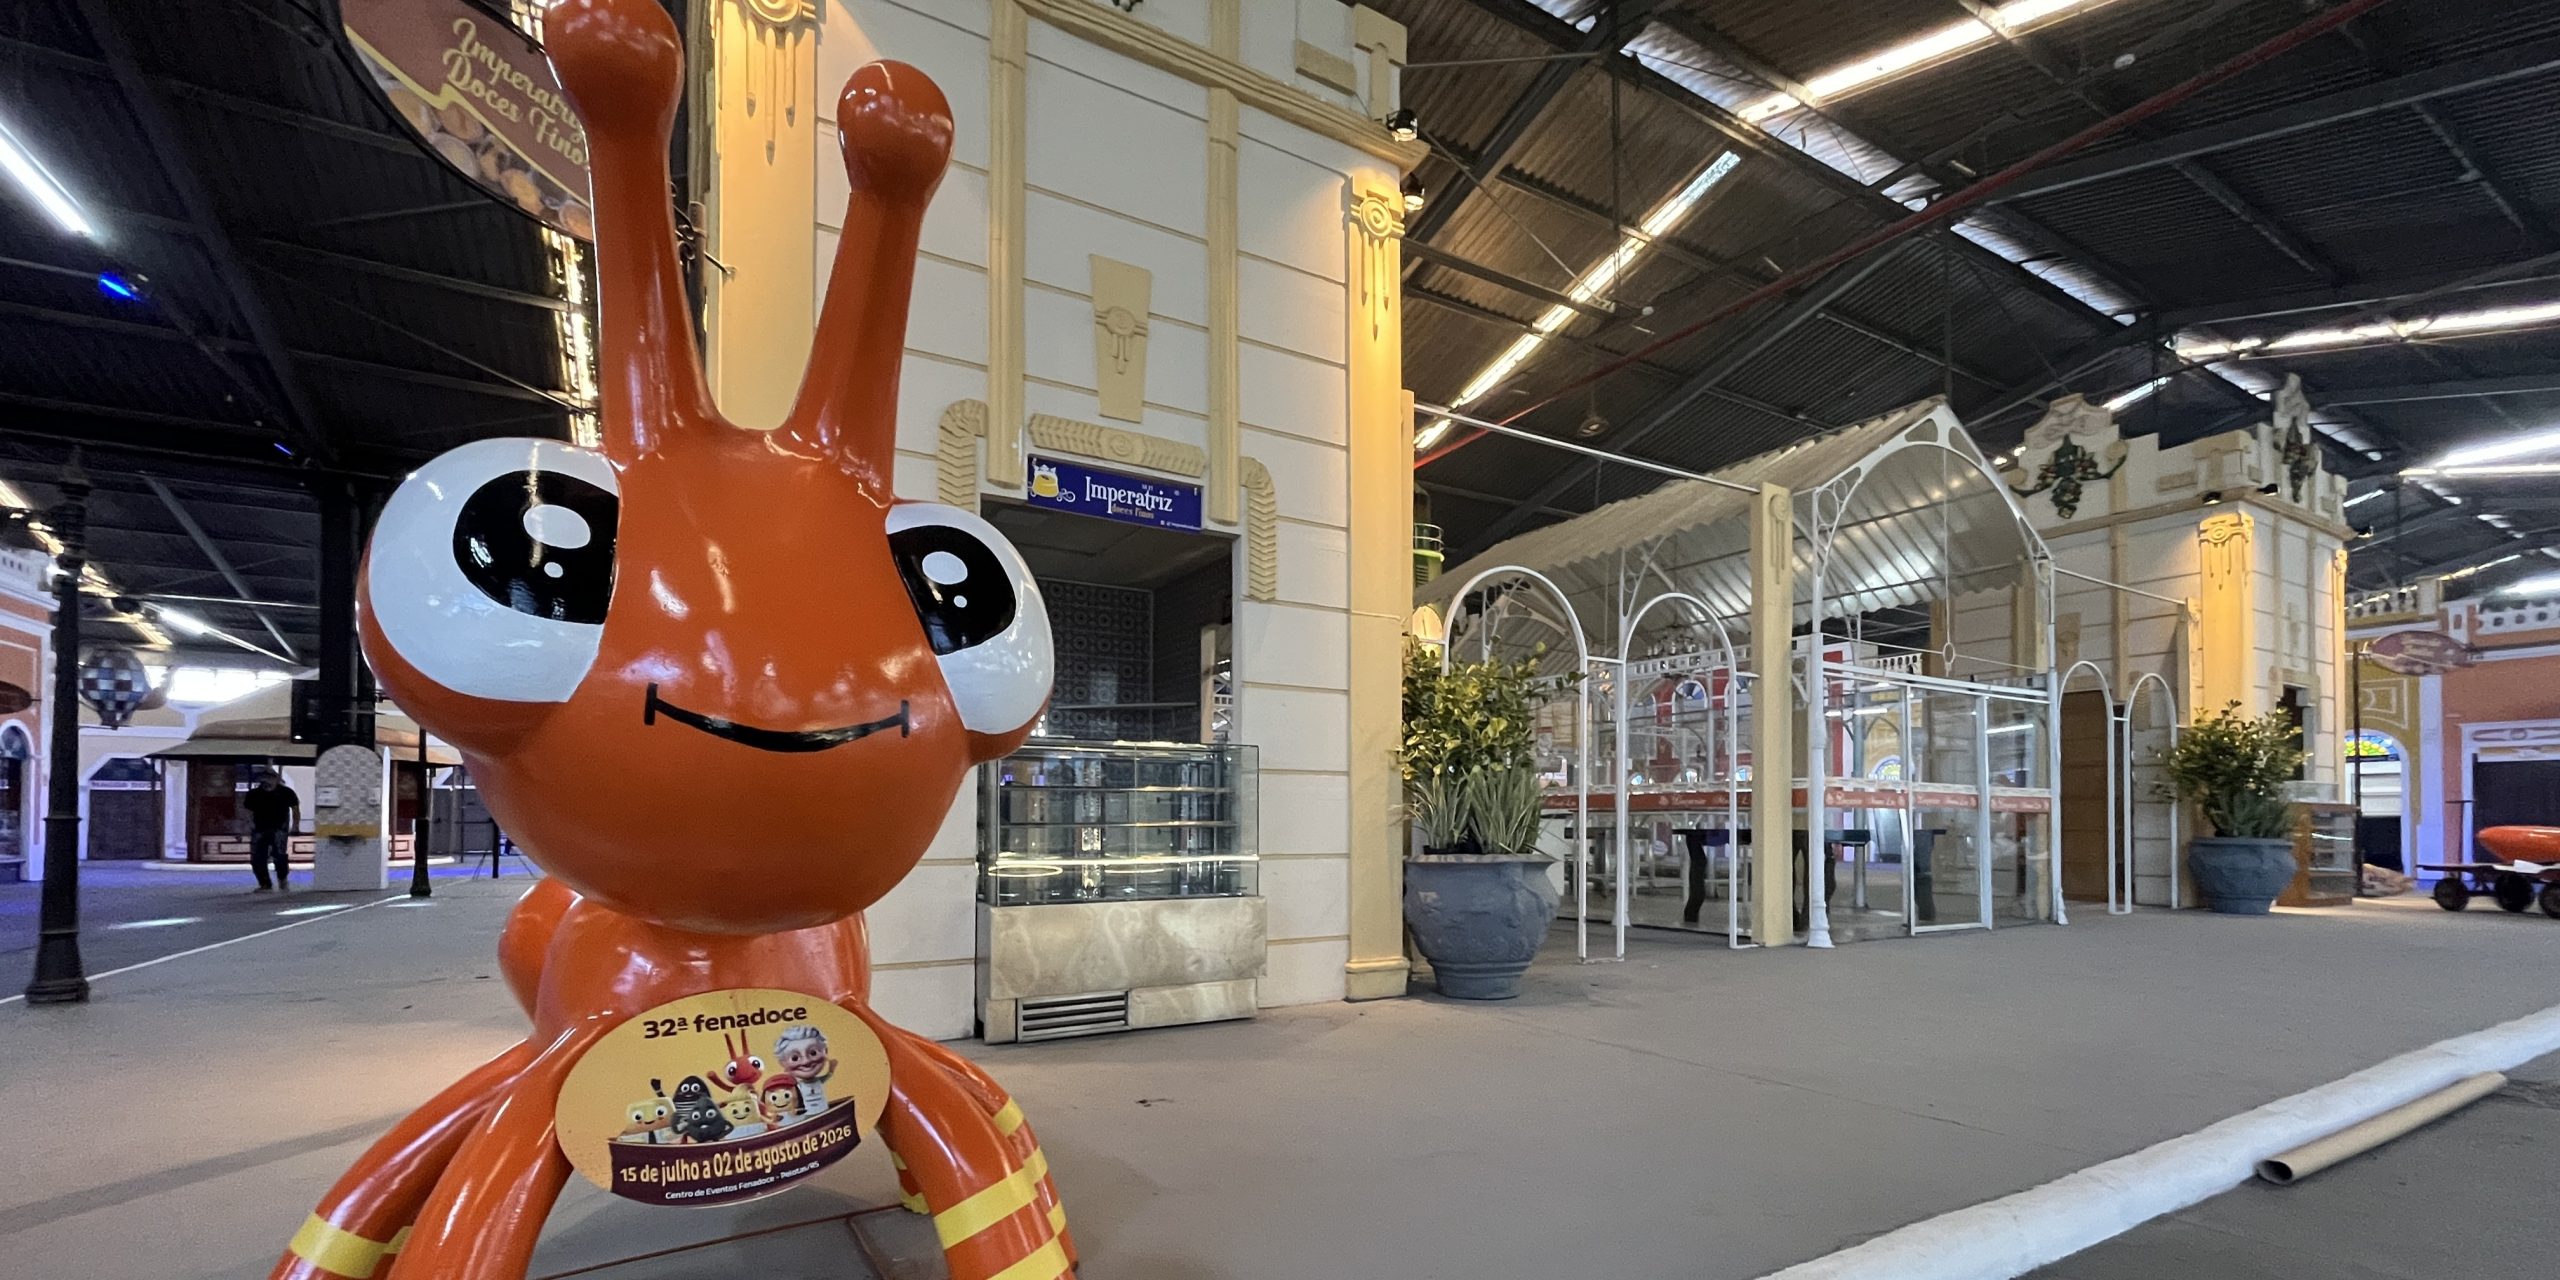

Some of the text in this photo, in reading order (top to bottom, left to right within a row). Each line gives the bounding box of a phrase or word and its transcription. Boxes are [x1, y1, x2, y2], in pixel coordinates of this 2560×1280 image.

[442, 48, 586, 166] Doces Fino
[1085, 476, 1173, 514] Imperatriz
[643, 1007, 807, 1039] 32ª fenadoce
[620, 1124, 852, 1187] 15 de julho a 02 de agosto de 2026
[665, 1190, 694, 1200] Centro
[694, 1188, 705, 1197] de
[705, 1184, 738, 1197] Eventos
[738, 1175, 775, 1190] Fenadoce
[780, 1160, 820, 1179] Pelotas/RS
